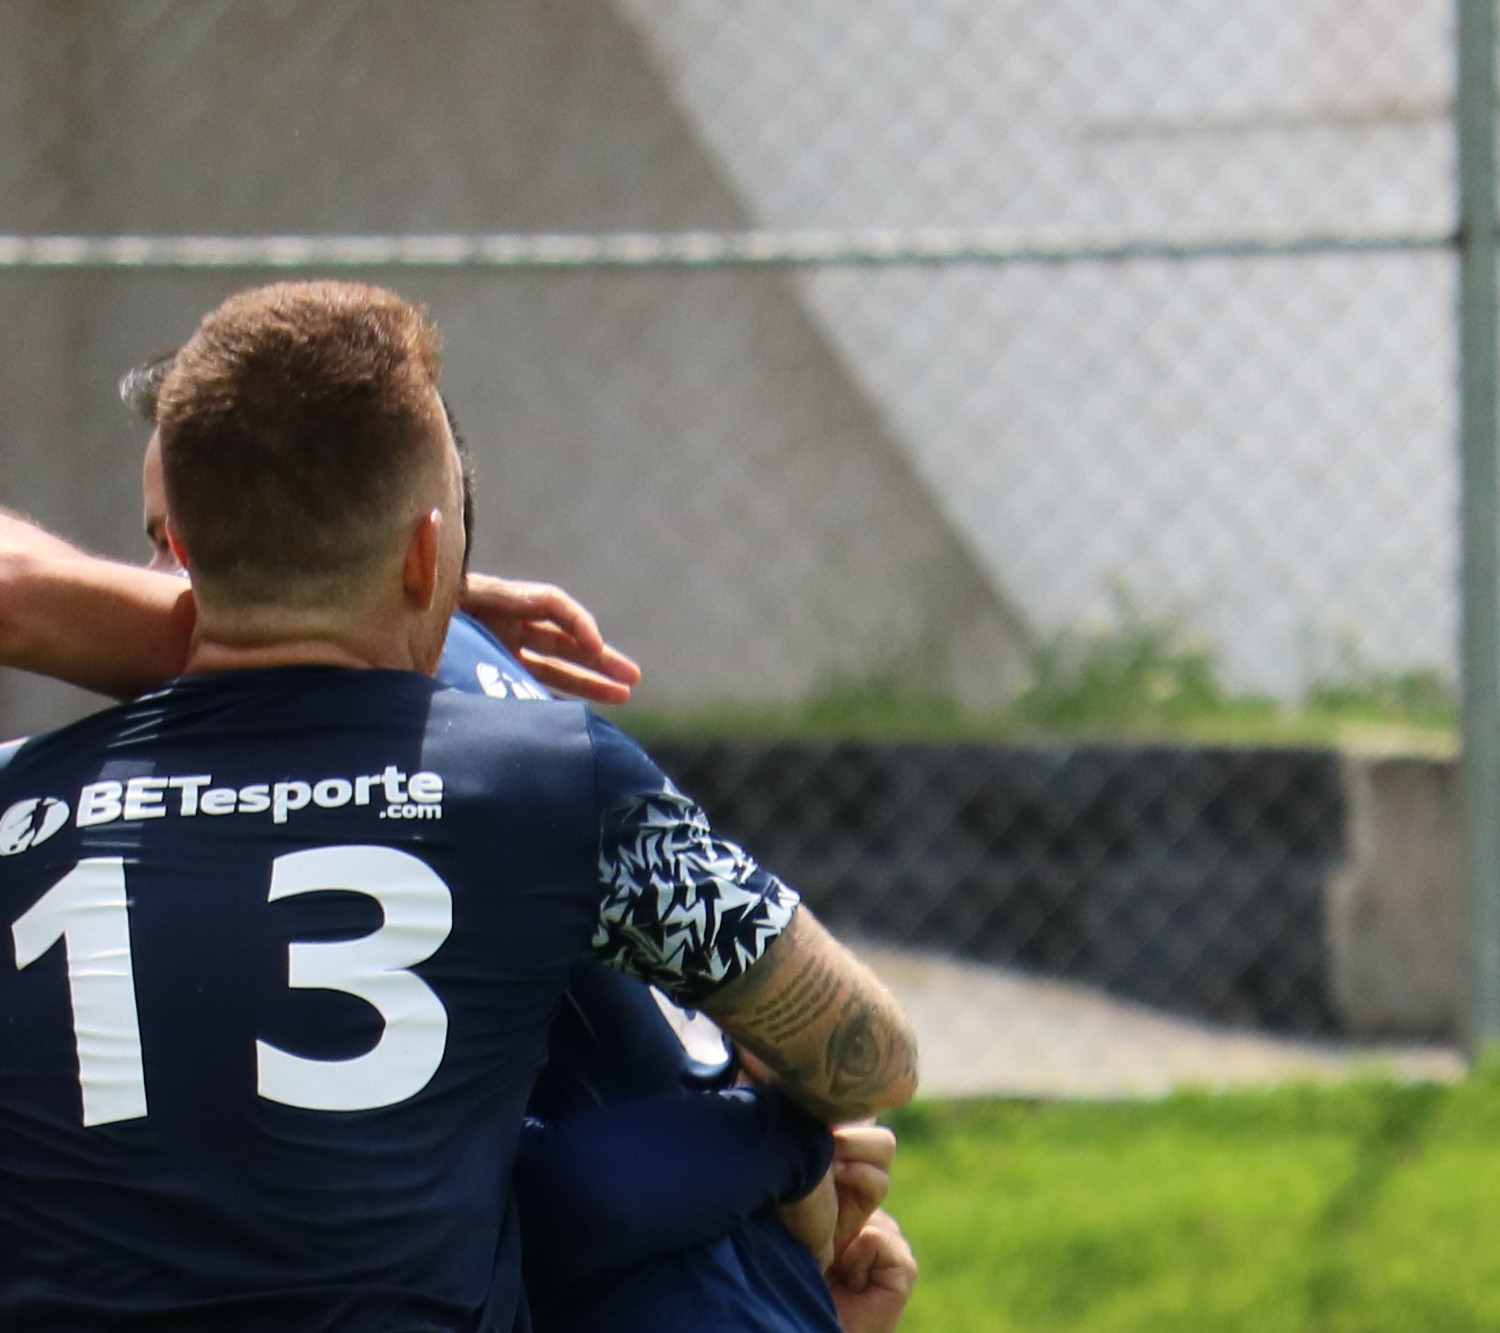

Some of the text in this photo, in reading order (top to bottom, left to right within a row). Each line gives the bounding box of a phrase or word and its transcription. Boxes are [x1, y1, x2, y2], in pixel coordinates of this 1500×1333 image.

[76, 765, 444, 828] BETesporte
[379, 796, 442, 820] .com
[11, 844, 453, 1128] 13
